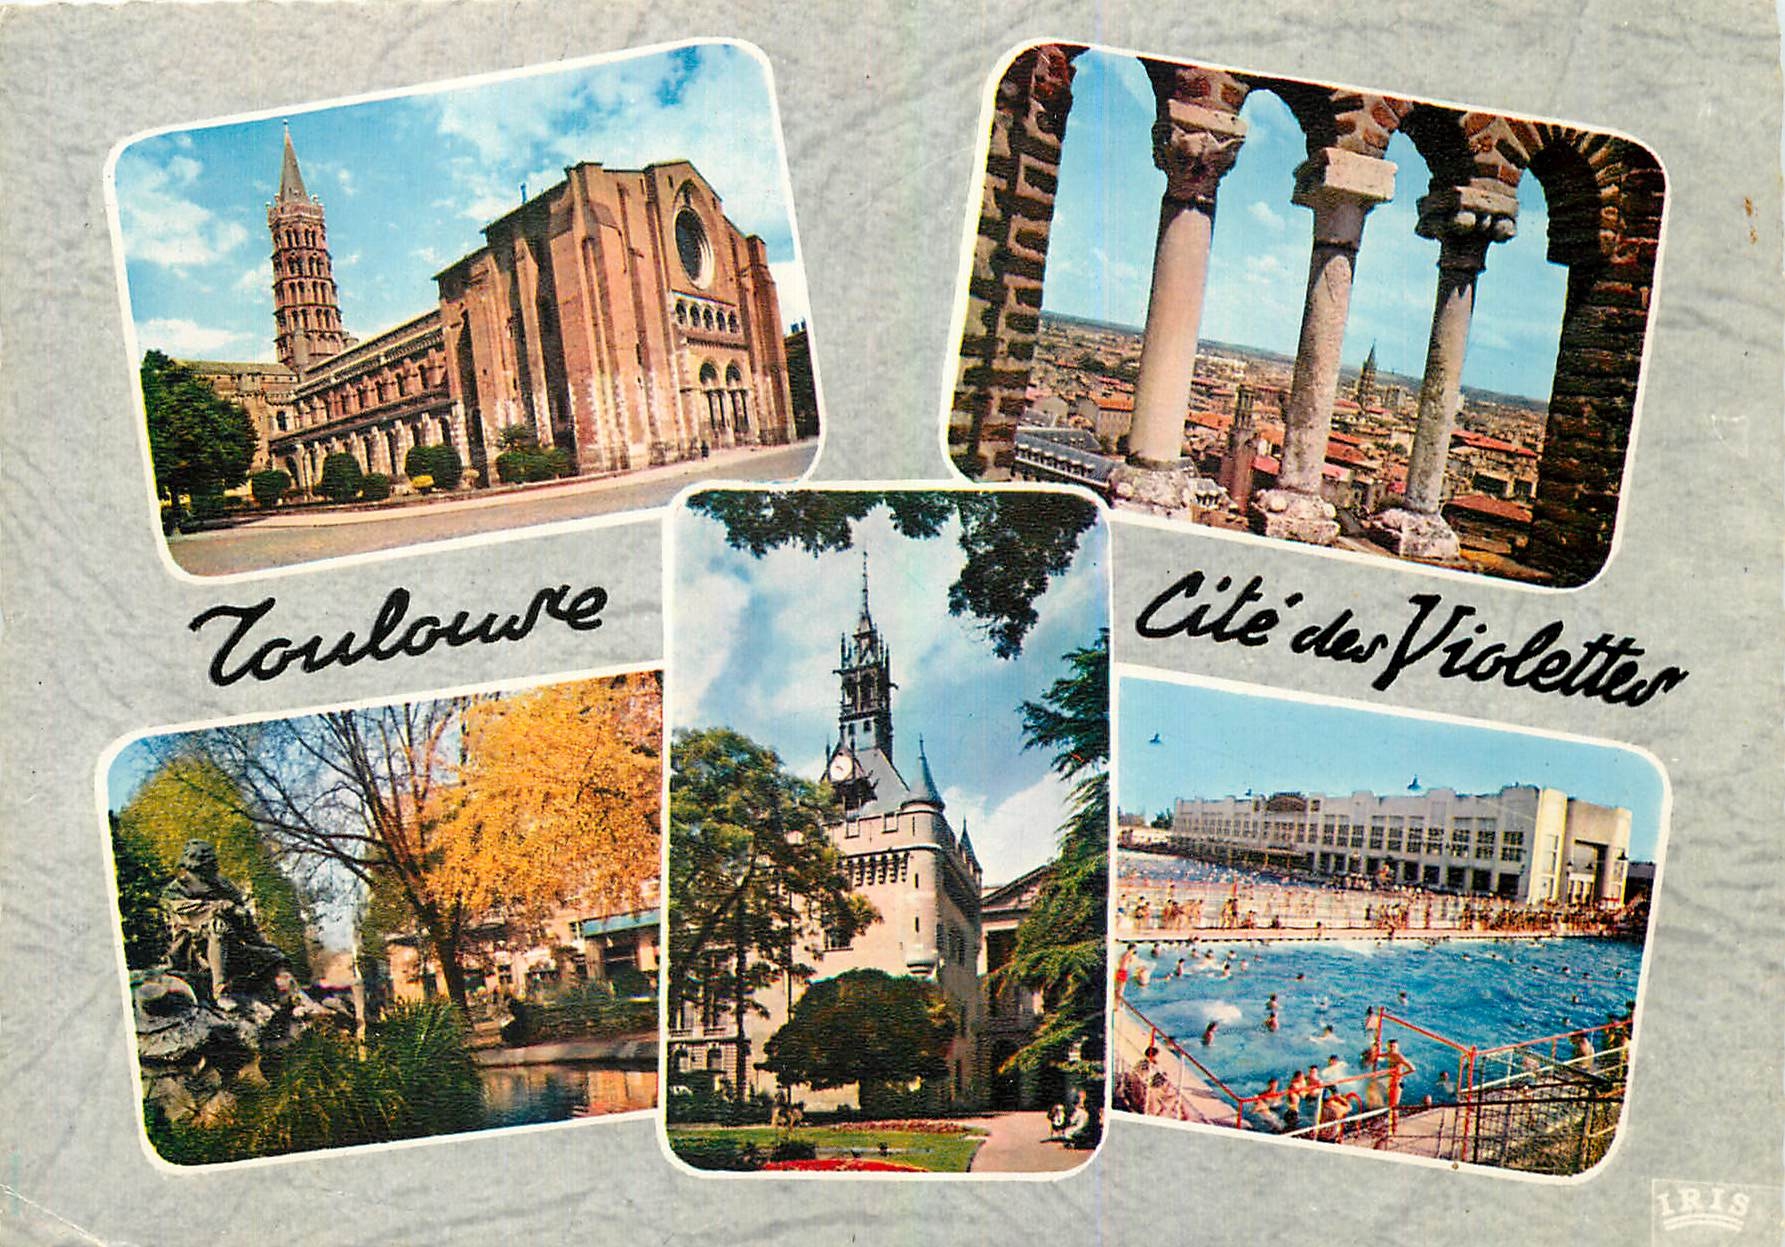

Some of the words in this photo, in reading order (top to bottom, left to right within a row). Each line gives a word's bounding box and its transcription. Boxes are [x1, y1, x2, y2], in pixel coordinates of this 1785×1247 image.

[188, 584, 608, 687] Toulouse
[1136, 570, 1304, 647] Cité
[1290, 608, 1389, 664] des
[1371, 593, 1690, 708] Violettes
[1657, 1187, 1751, 1217] IRIS
